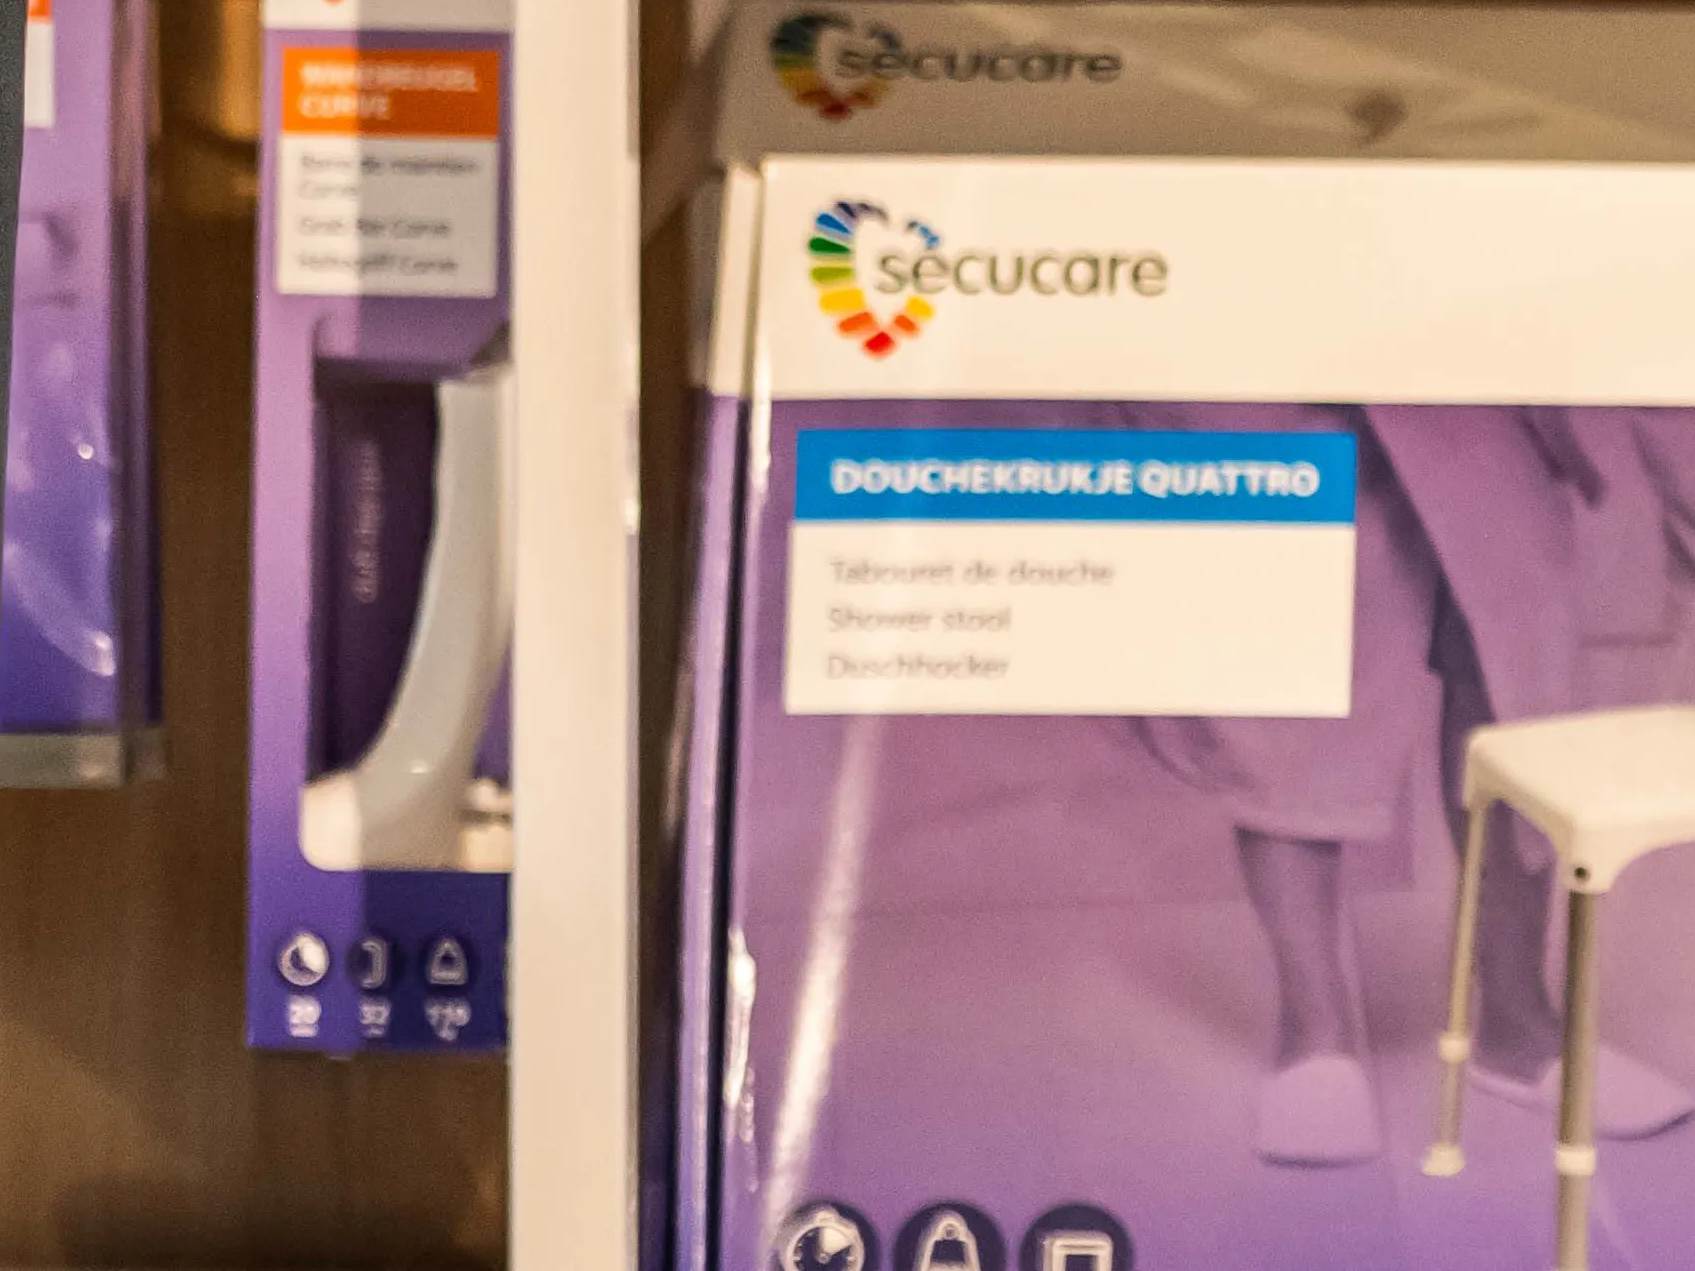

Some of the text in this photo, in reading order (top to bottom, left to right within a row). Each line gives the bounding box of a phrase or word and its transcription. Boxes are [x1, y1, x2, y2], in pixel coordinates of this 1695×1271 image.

[837, 42, 1122, 81] secucare
[874, 249, 1169, 297] secucare
[830, 460, 1321, 499] DOUCHEKRUKJE QUATTRO
[830, 559, 1114, 585] Tabouret de douche
[827, 607, 1012, 632] Shower stool
